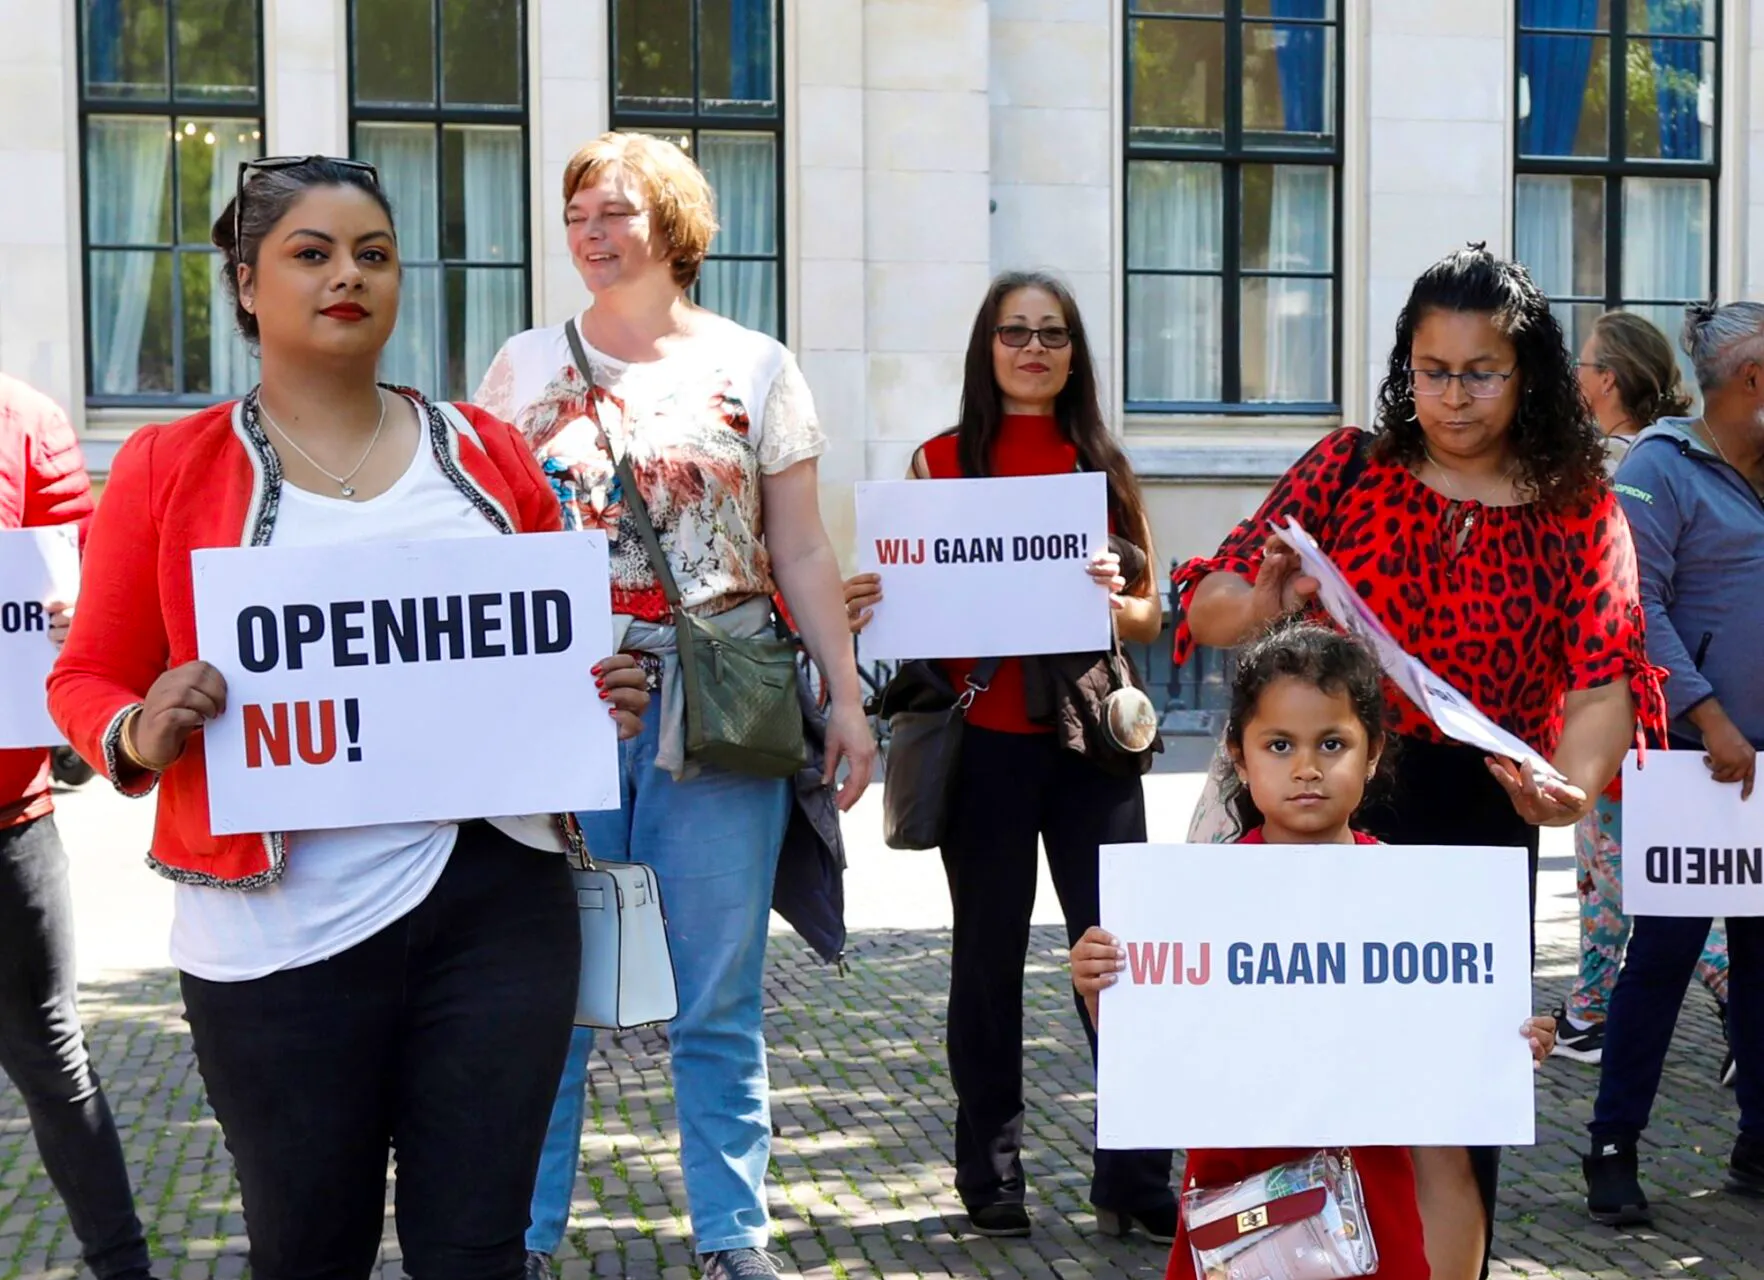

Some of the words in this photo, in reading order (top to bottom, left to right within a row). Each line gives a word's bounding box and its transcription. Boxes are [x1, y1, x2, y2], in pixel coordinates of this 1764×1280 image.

[875, 539, 925, 565] WIJ
[934, 537, 1004, 564] GAAN
[1012, 533, 1088, 562] DOOR!
[2, 601, 54, 633] OR
[237, 589, 573, 673] OPENHEID
[243, 698, 362, 768] NU!
[1127, 942, 1211, 986] WIJ
[1227, 941, 1346, 986] GAAN
[1362, 941, 1494, 985] DOOR!
